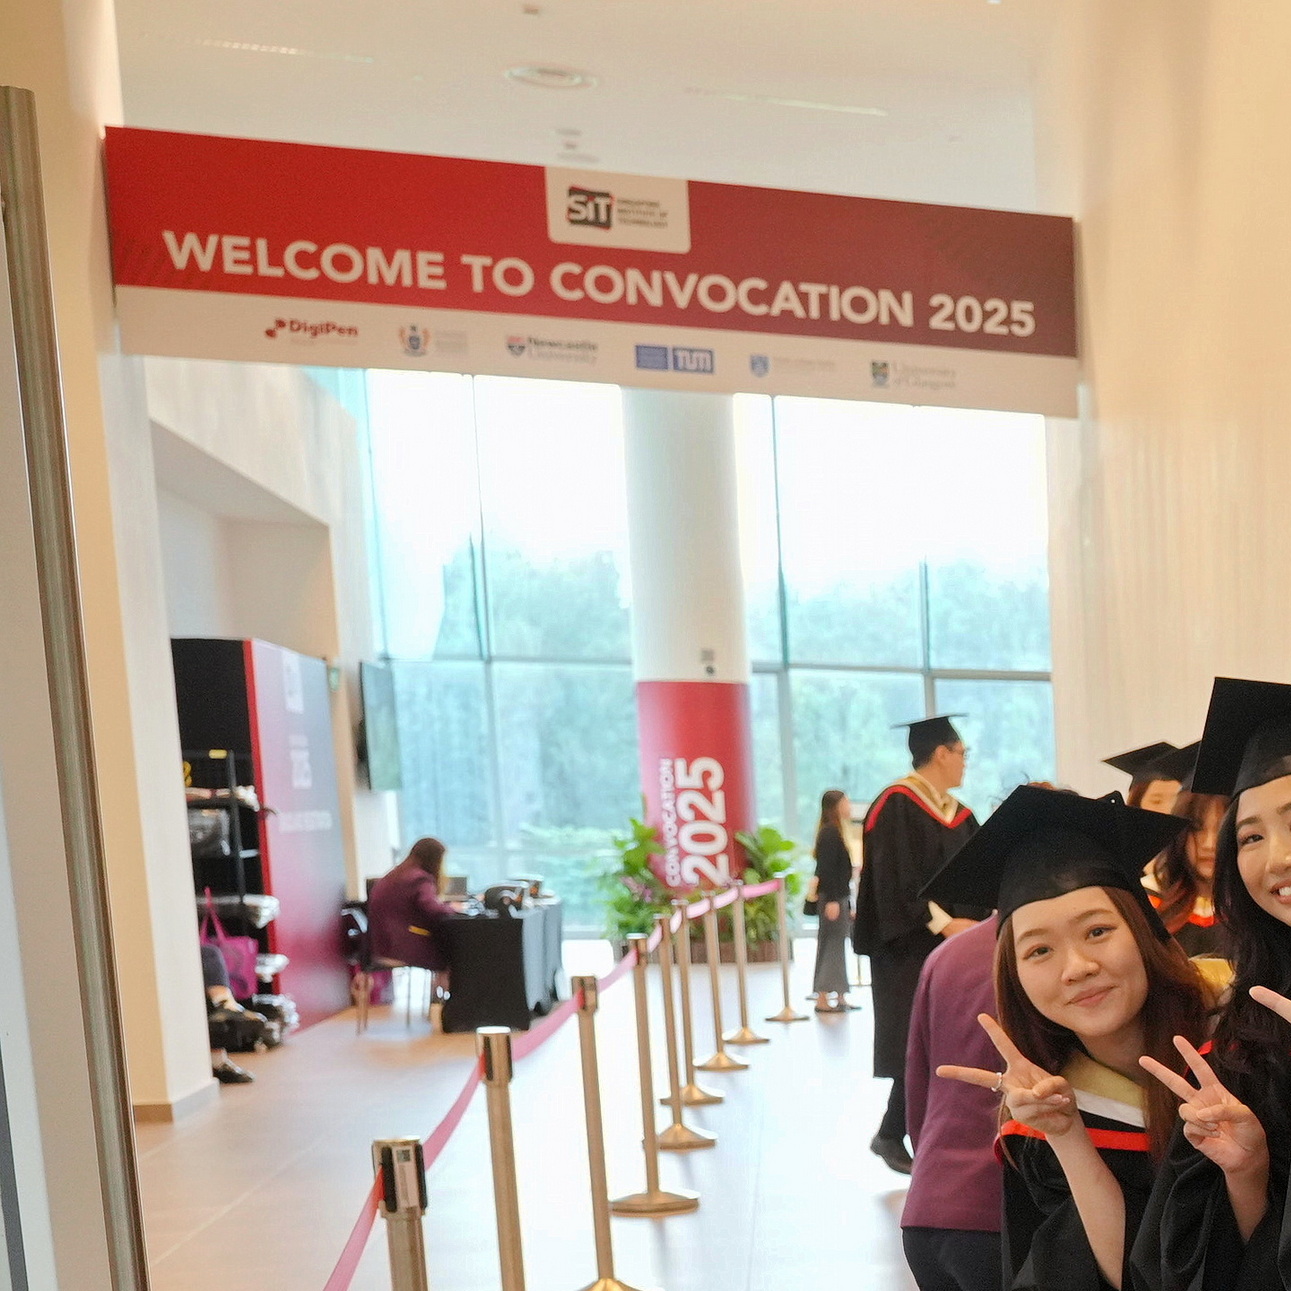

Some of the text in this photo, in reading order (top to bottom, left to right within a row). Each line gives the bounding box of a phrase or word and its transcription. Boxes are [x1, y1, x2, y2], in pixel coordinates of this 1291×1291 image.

[162, 230, 1036, 337] WELCOME TO CONVOCATION 2025
[289, 319, 359, 339] DigiPen
[660, 758, 681, 887] CONVOCATION
[675, 756, 730, 888] 2025
